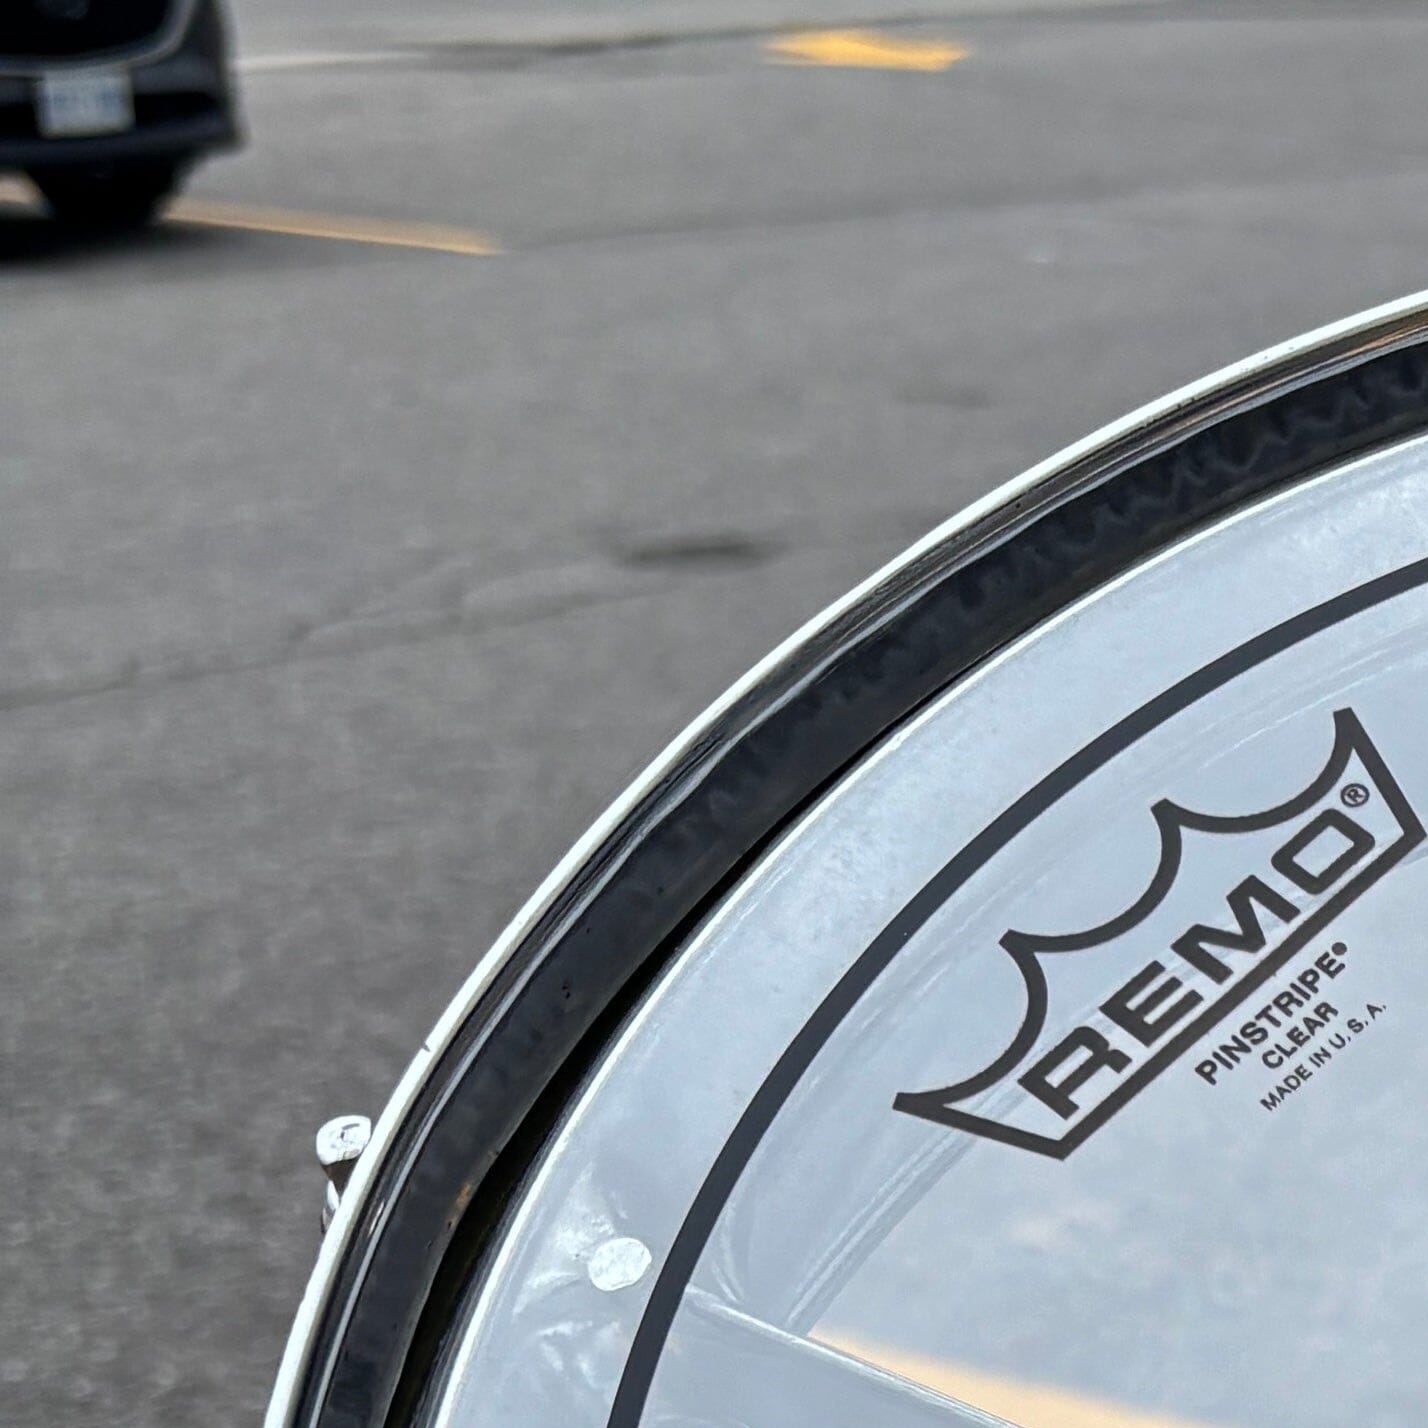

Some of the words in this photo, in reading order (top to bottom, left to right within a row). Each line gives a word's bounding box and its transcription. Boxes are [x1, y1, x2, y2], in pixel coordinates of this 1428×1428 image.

[1261, 1002, 1339, 1069] CLEAR
[1260, 1063, 1313, 1111] MADE
[1308, 1046, 1333, 1068] IN
